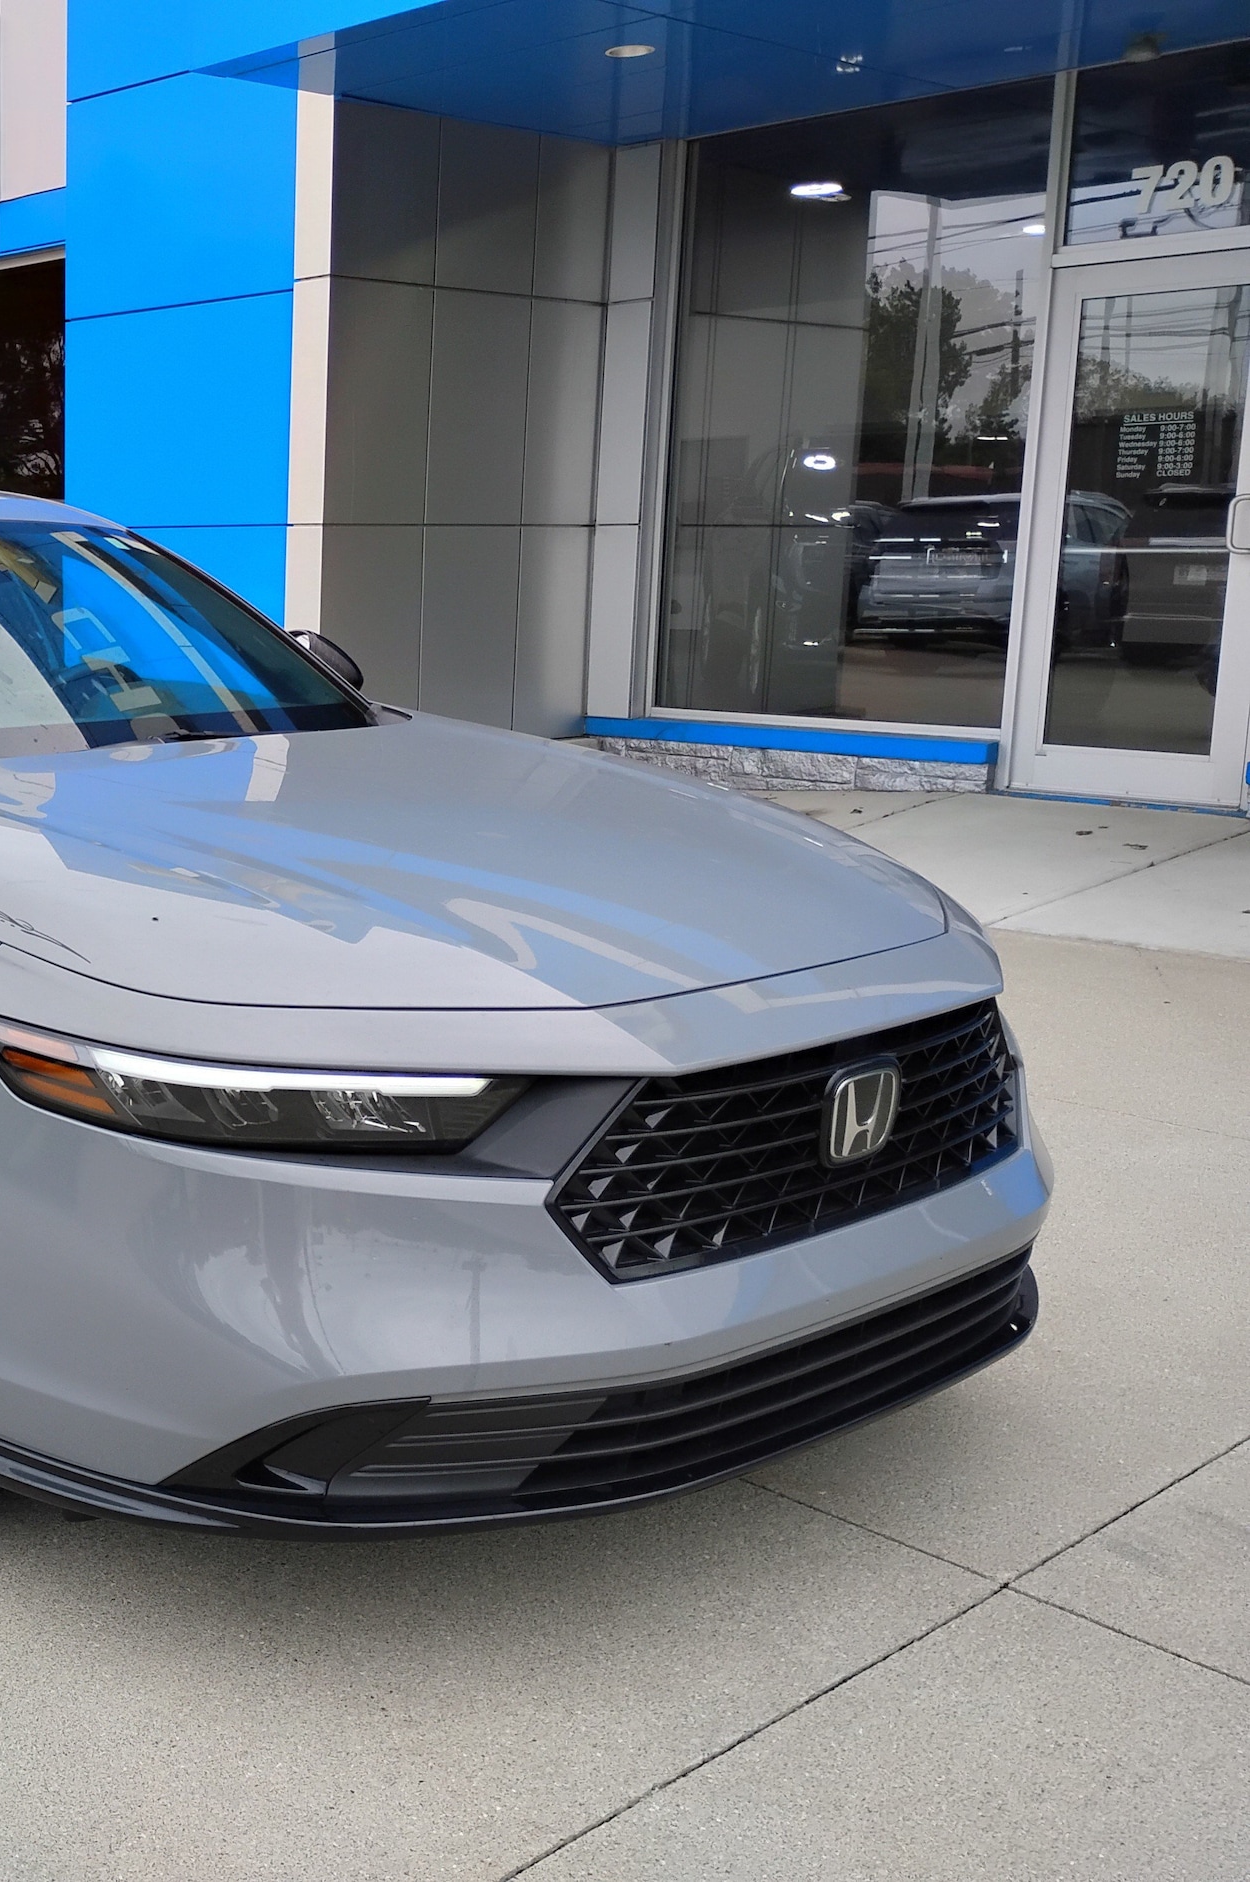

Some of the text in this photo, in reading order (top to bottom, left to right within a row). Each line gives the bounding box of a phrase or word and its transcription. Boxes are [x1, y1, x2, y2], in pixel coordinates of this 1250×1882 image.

[1131, 155, 1235, 214] 720
[1124, 411, 1194, 422] SALES HOURS
